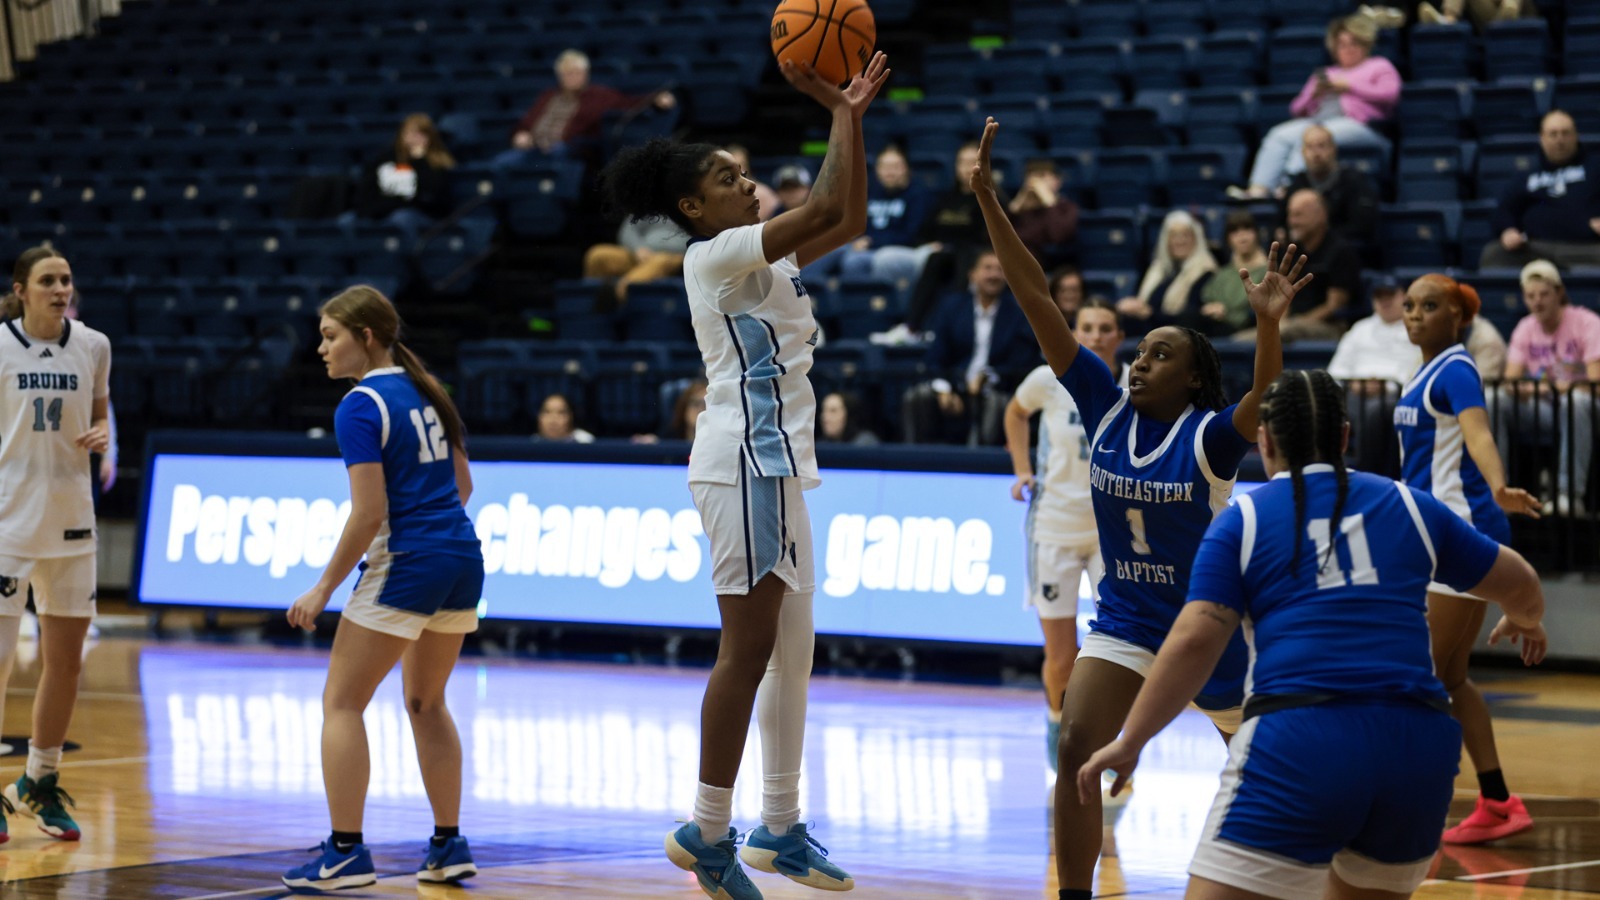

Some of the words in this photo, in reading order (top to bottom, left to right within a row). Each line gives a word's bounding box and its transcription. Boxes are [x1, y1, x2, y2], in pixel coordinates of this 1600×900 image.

[17, 373, 78, 391] BRUINS
[32, 396, 63, 431] 14
[409, 405, 449, 464] 12
[1091, 463, 1194, 503] SOUTHEASTERN
[166, 484, 353, 579] Perspe
[475, 492, 703, 588] changes
[822, 513, 1006, 597] game.
[1125, 507, 1152, 555] 1
[1306, 512, 1380, 590] 11
[1115, 558, 1175, 585] BAPTIST
